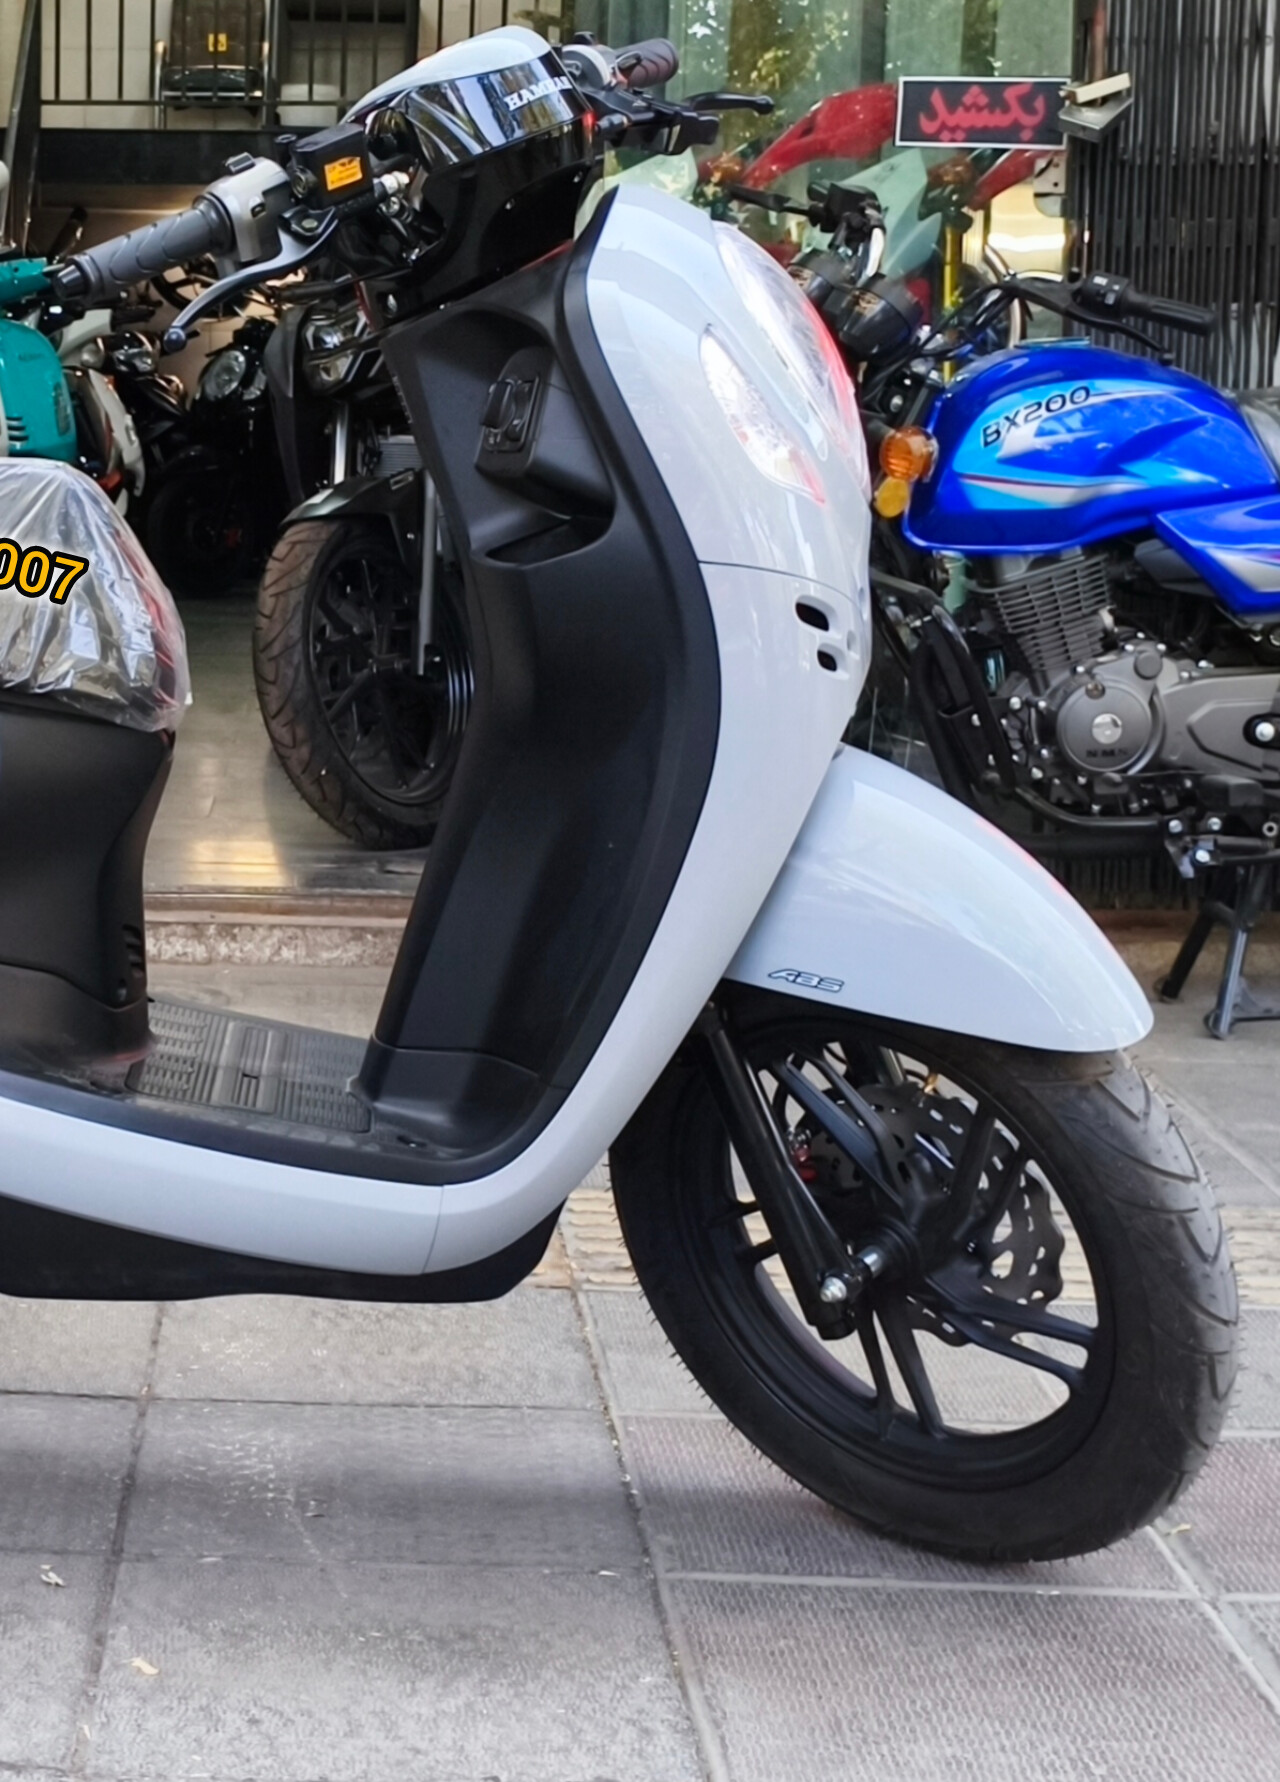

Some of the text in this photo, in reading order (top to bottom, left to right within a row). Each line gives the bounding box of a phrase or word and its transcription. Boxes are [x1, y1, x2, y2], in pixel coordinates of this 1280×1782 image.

[919, 82, 1046, 142] بکشید
[982, 386, 1091, 448] BX200
[767, 968, 845, 993] ABS
